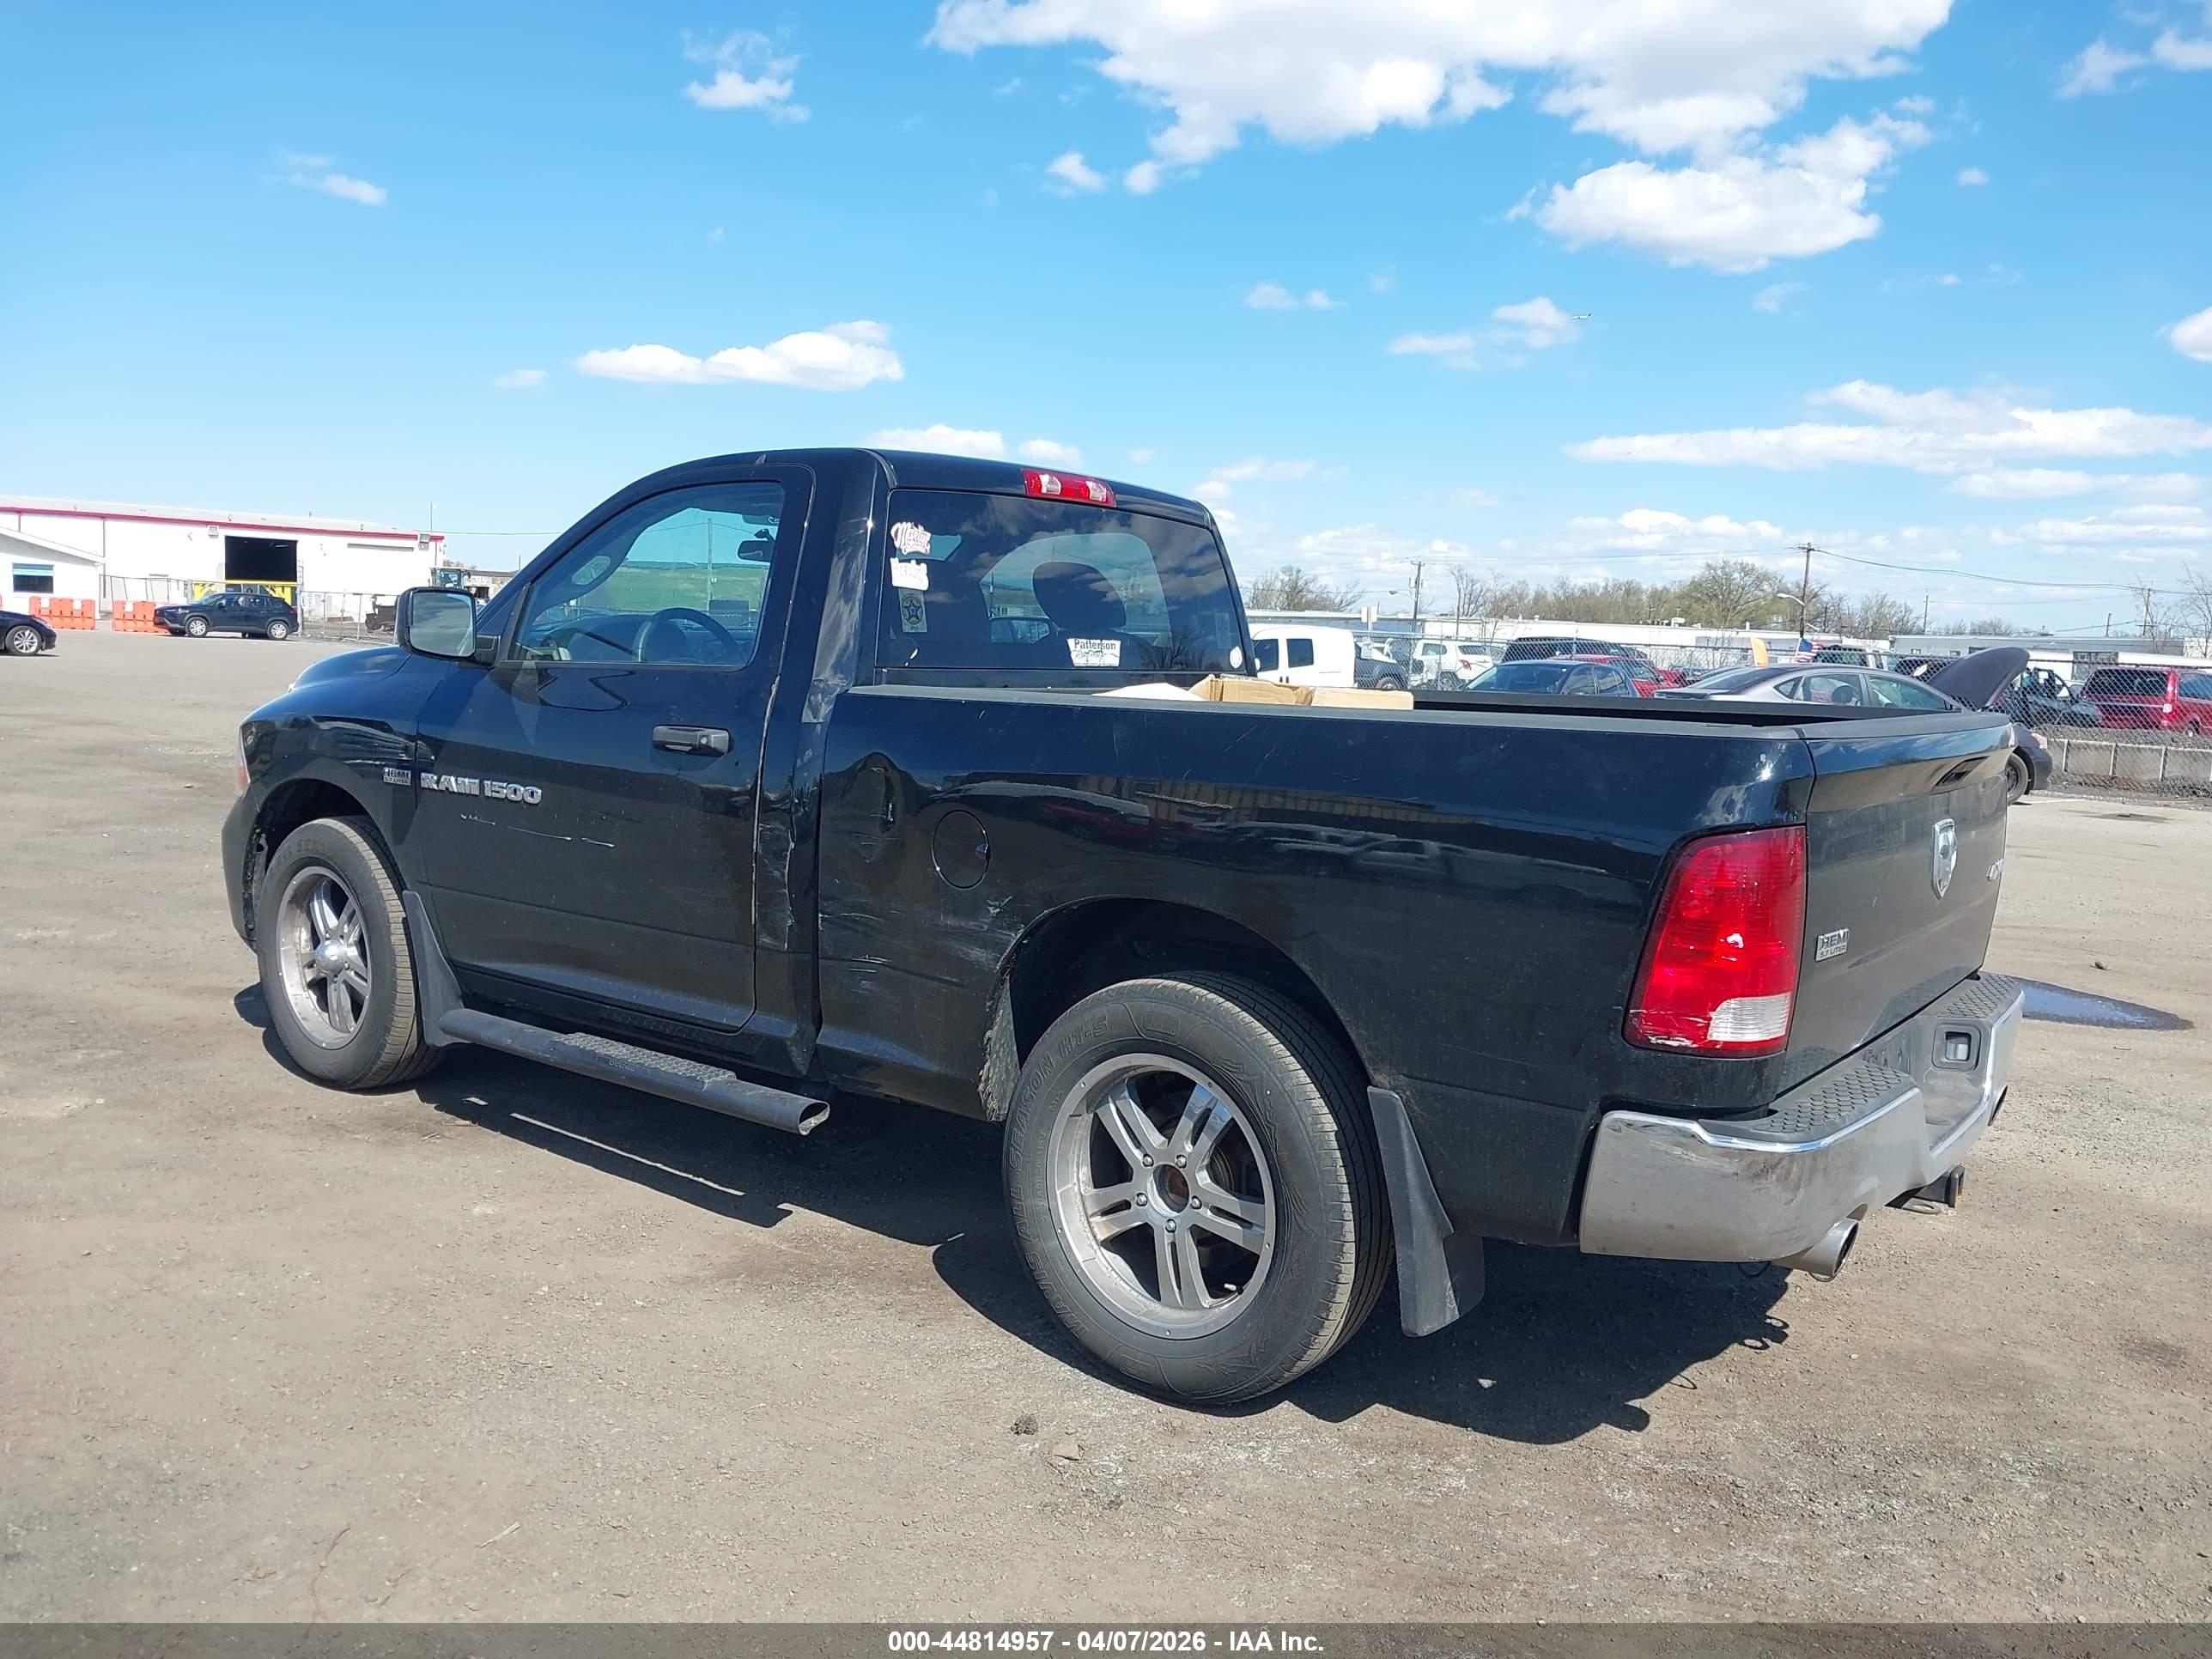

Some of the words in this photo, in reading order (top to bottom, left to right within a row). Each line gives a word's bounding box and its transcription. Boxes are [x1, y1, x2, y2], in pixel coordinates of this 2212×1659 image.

[1073, 639, 1116, 651] Patterson
[421, 772, 479, 796] RAM
[483, 780, 542, 805] 1500
[1820, 930, 1849, 950] HEMI
[1830, 945, 1847, 955] LITER
[1008, 1051, 1056, 1173] SEASON
[1010, 1187, 1032, 1243] ALL
